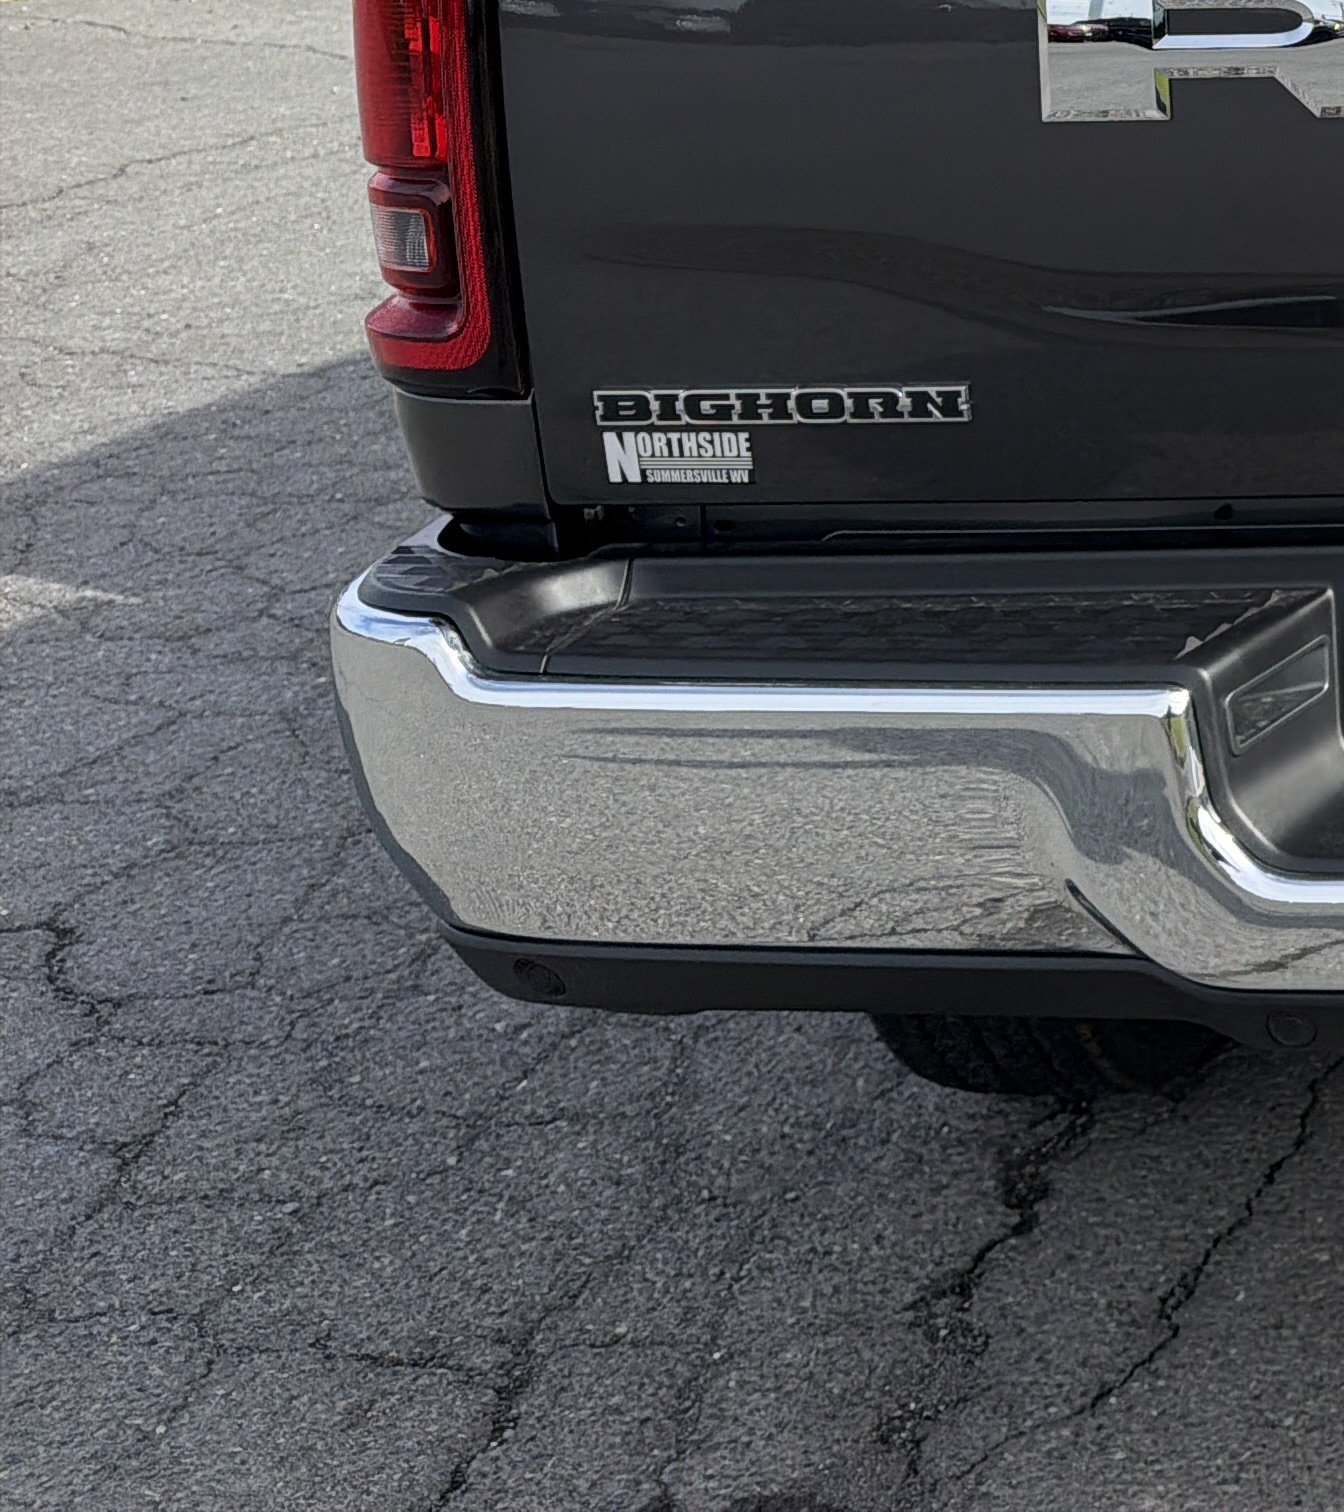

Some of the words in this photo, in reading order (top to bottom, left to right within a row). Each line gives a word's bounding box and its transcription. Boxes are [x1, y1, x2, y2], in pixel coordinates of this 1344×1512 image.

[593, 385, 974, 426] BIGHORN
[603, 431, 752, 483] NORTHSIDE
[730, 469, 749, 484] WV
